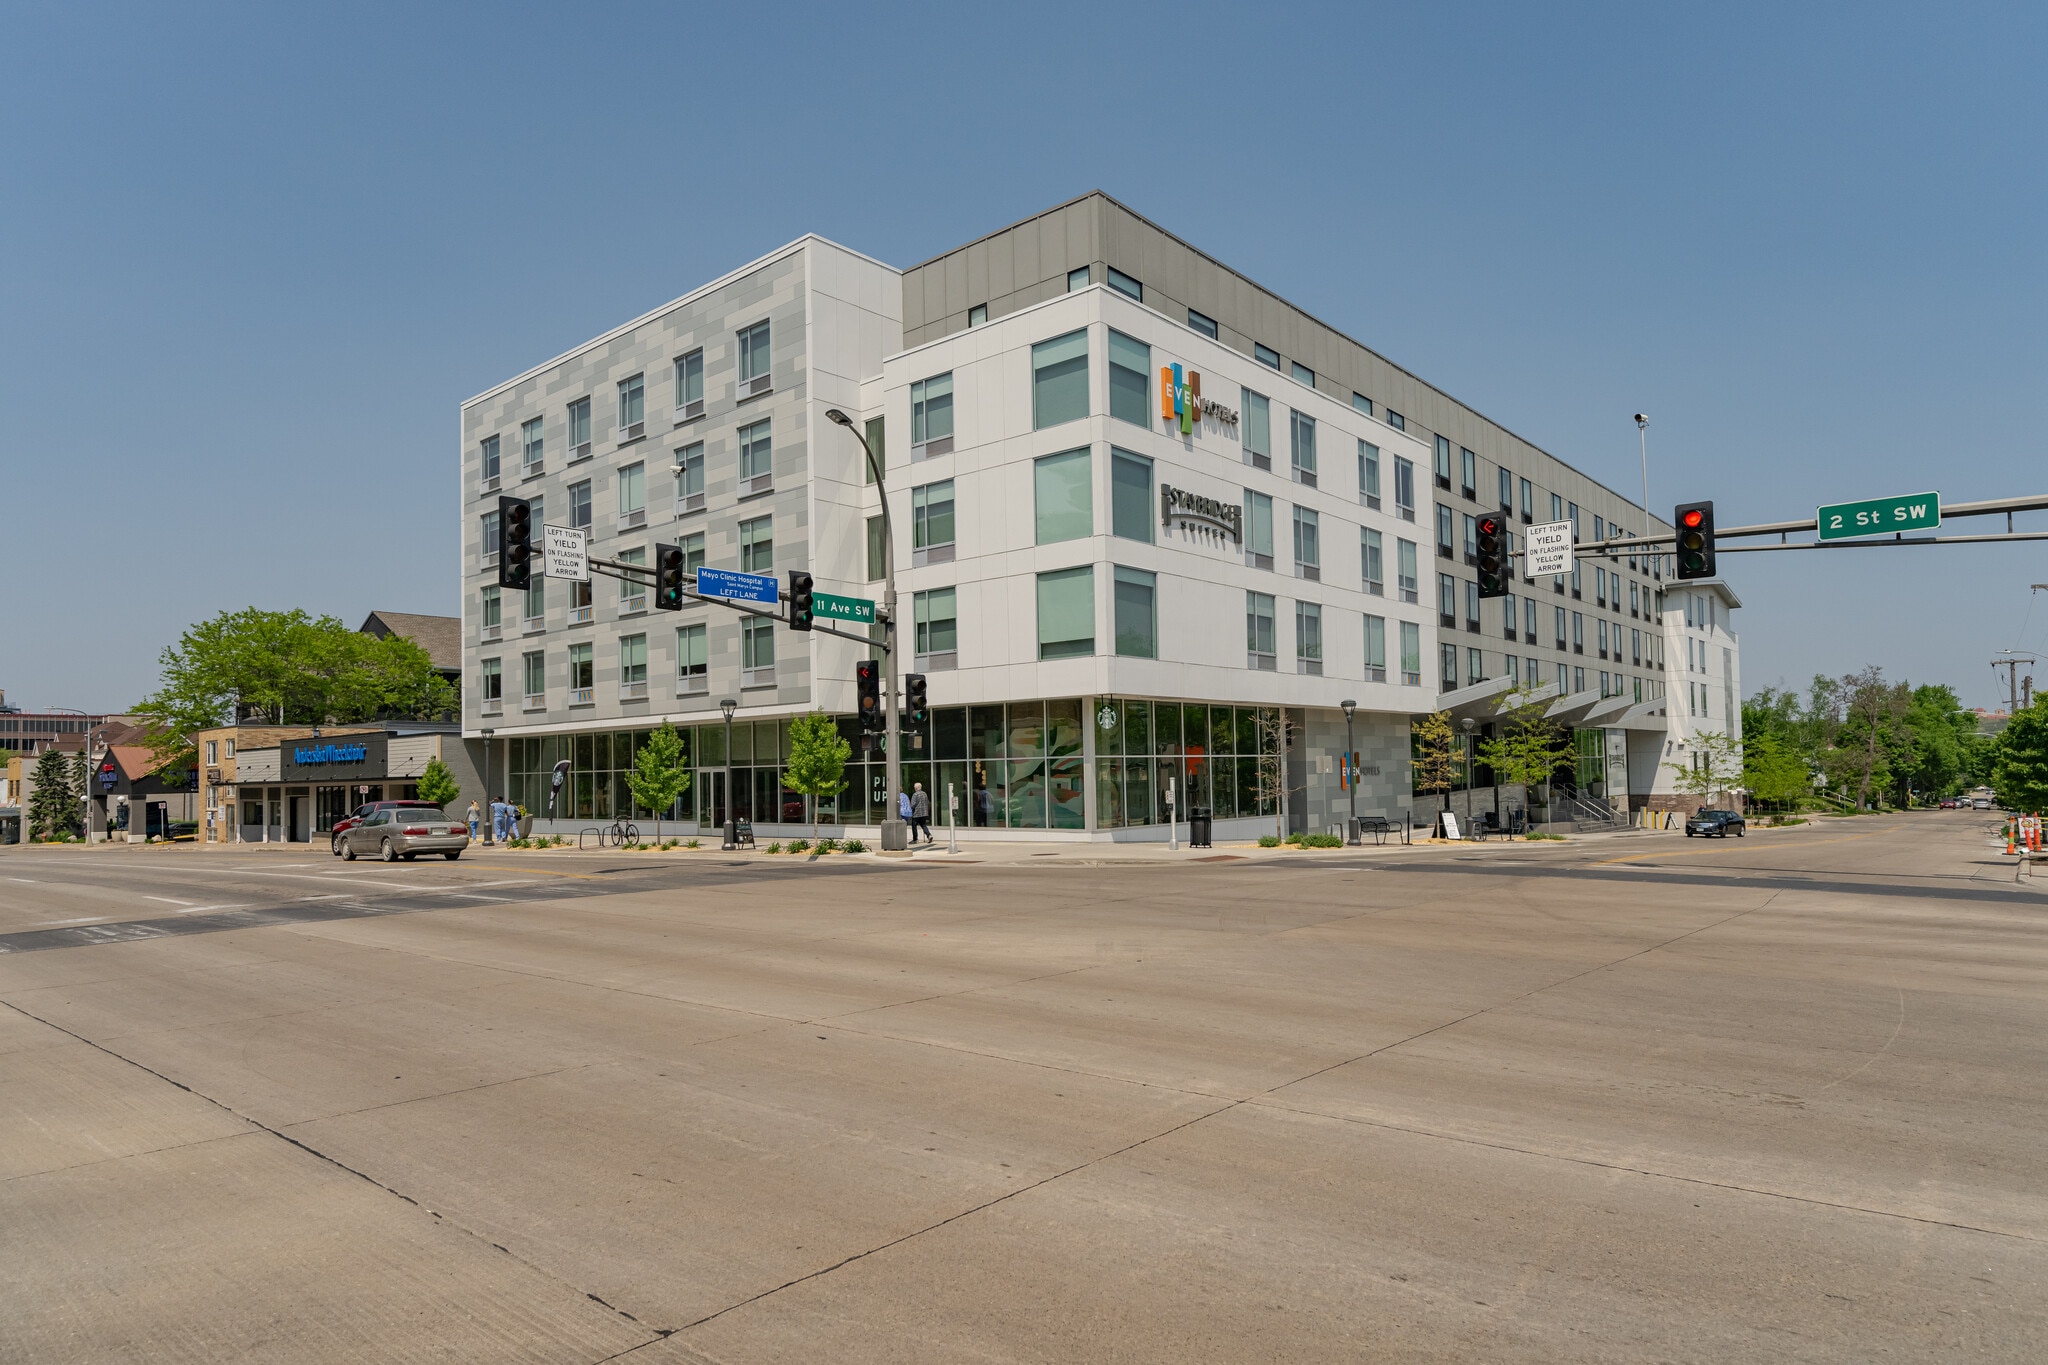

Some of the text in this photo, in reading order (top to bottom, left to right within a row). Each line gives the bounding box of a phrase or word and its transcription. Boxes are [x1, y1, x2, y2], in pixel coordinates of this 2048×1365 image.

[1166, 382, 1239, 424] EVEN HOTELS
[1170, 487, 1235, 522] STAYBRIDGE
[1830, 504, 1926, 529] 2 St SW
[547, 528, 582, 540] LEFT TURN
[1181, 521, 1226, 540] SUITES
[1530, 524, 1568, 536] LEFT TURN
[553, 538, 577, 549] YIELD
[1536, 534, 1562, 545] YIELD
[1540, 544, 1569, 554] FLASHING
[557, 550, 584, 560] FLASHING
[1536, 554, 1564, 563] YELLOW
[553, 558, 579, 568] YELLOW
[1537, 564, 1562, 572] ARROW
[555, 568, 578, 577] ARROW
[701, 570, 763, 586] Mayo Clinic Hospital
[720, 588, 758, 600] LEFT LANE
[817, 600, 870, 617] 11 Ave SW
[874, 791, 888, 802] UP
